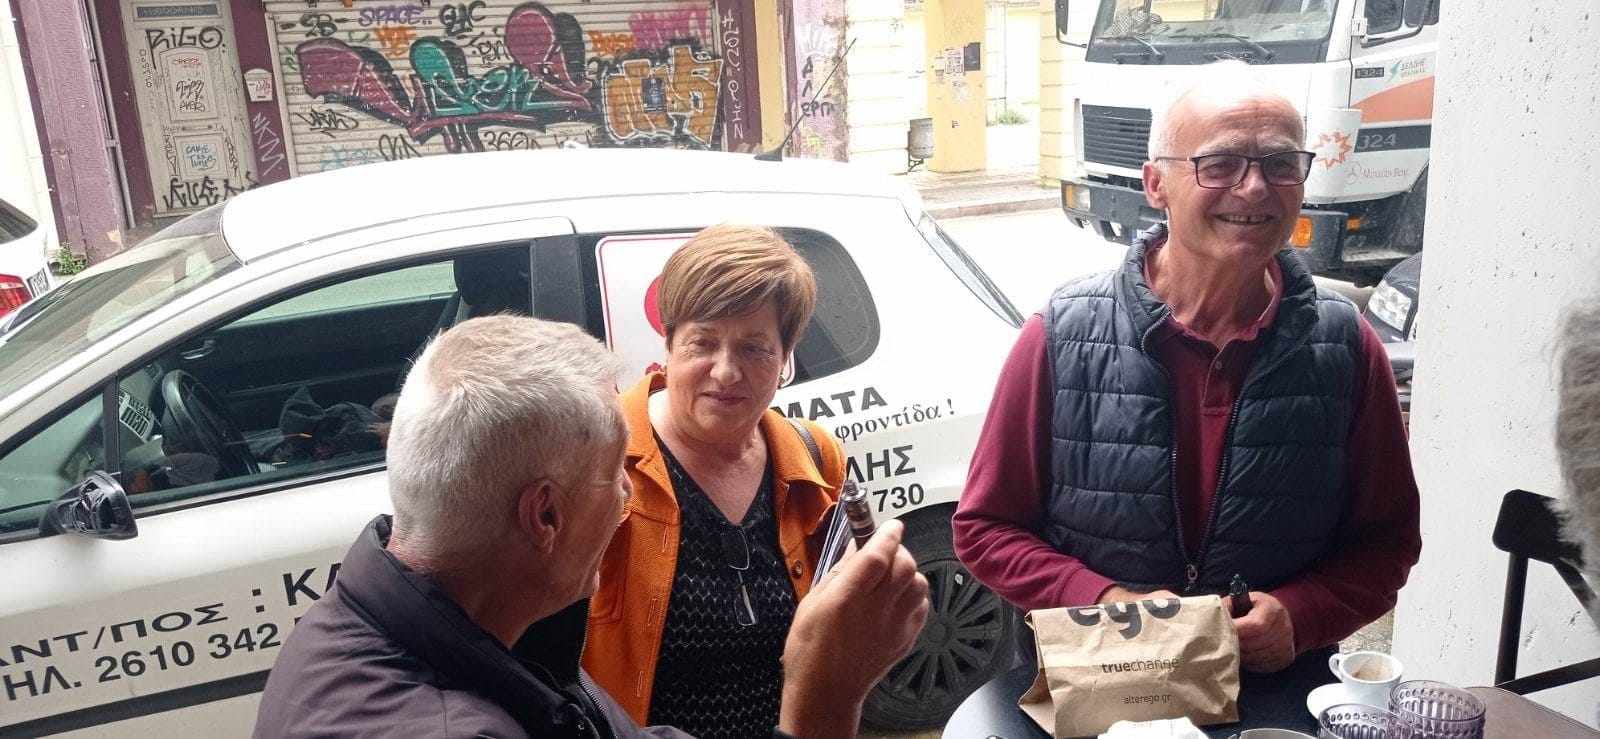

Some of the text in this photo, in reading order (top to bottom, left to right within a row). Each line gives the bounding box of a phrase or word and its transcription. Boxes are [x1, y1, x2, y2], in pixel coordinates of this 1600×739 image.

[1356, 68, 1384, 78] 1324
[834, 404, 942, 442] φροντίδα
[872, 483, 925, 513] 730
[94, 641, 195, 683] 2610
[207, 622, 281, 660] 342
[1101, 656, 1180, 674] truechange
[1122, 693, 1172, 705] alterego.gr
